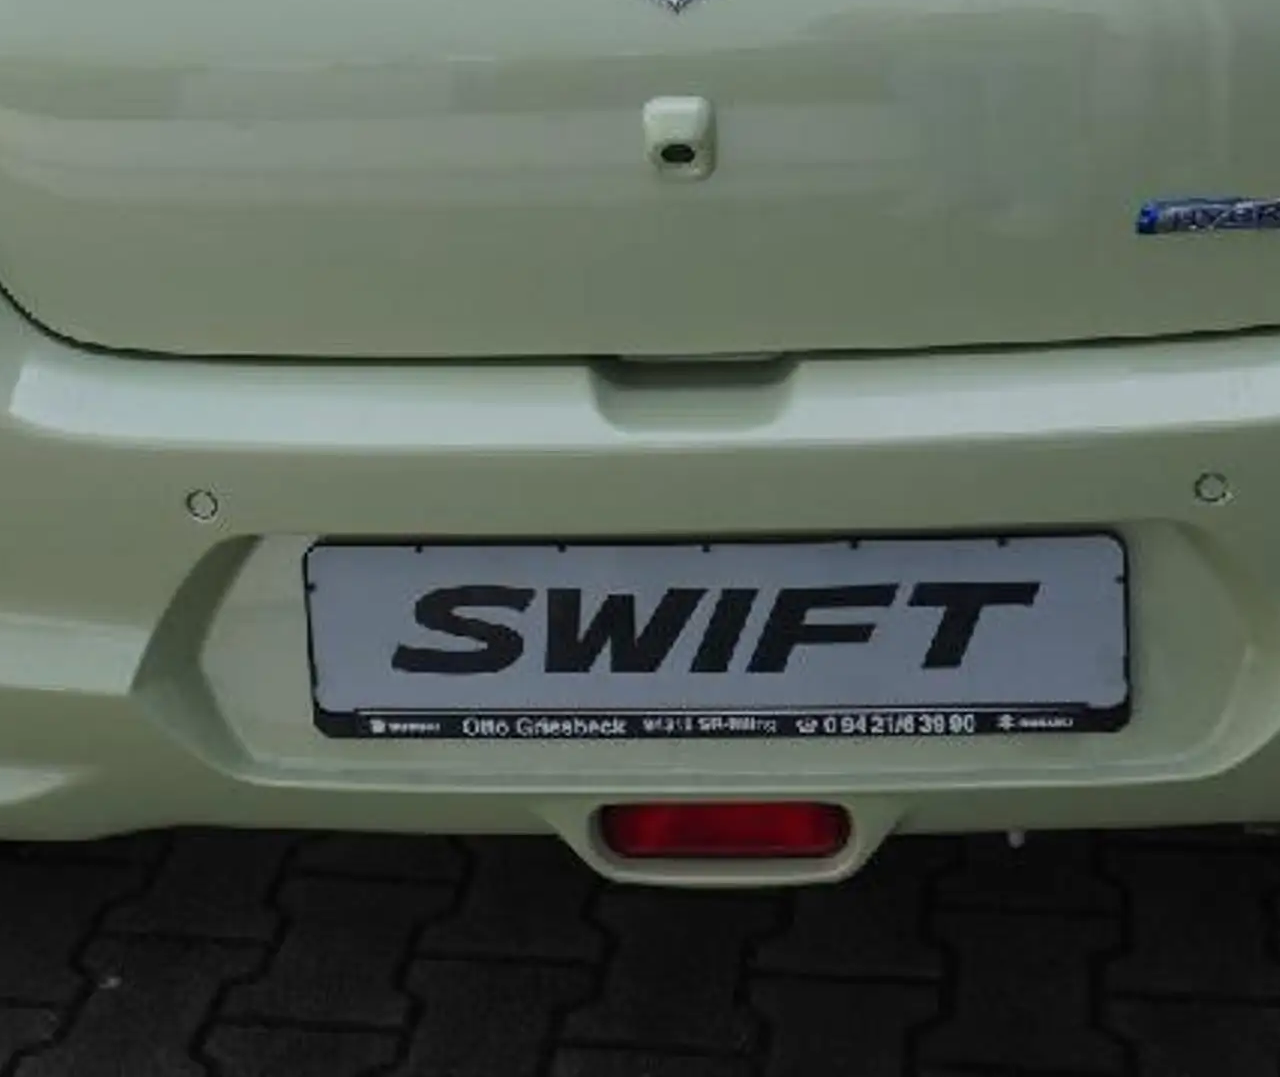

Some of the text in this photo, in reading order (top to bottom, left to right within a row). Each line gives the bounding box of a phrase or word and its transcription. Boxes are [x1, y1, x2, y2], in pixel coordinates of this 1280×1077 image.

[392, 581, 1041, 674] SWIFT
[462, 717, 510, 736] Otto
[516, 716, 627, 736] Griesbeck
